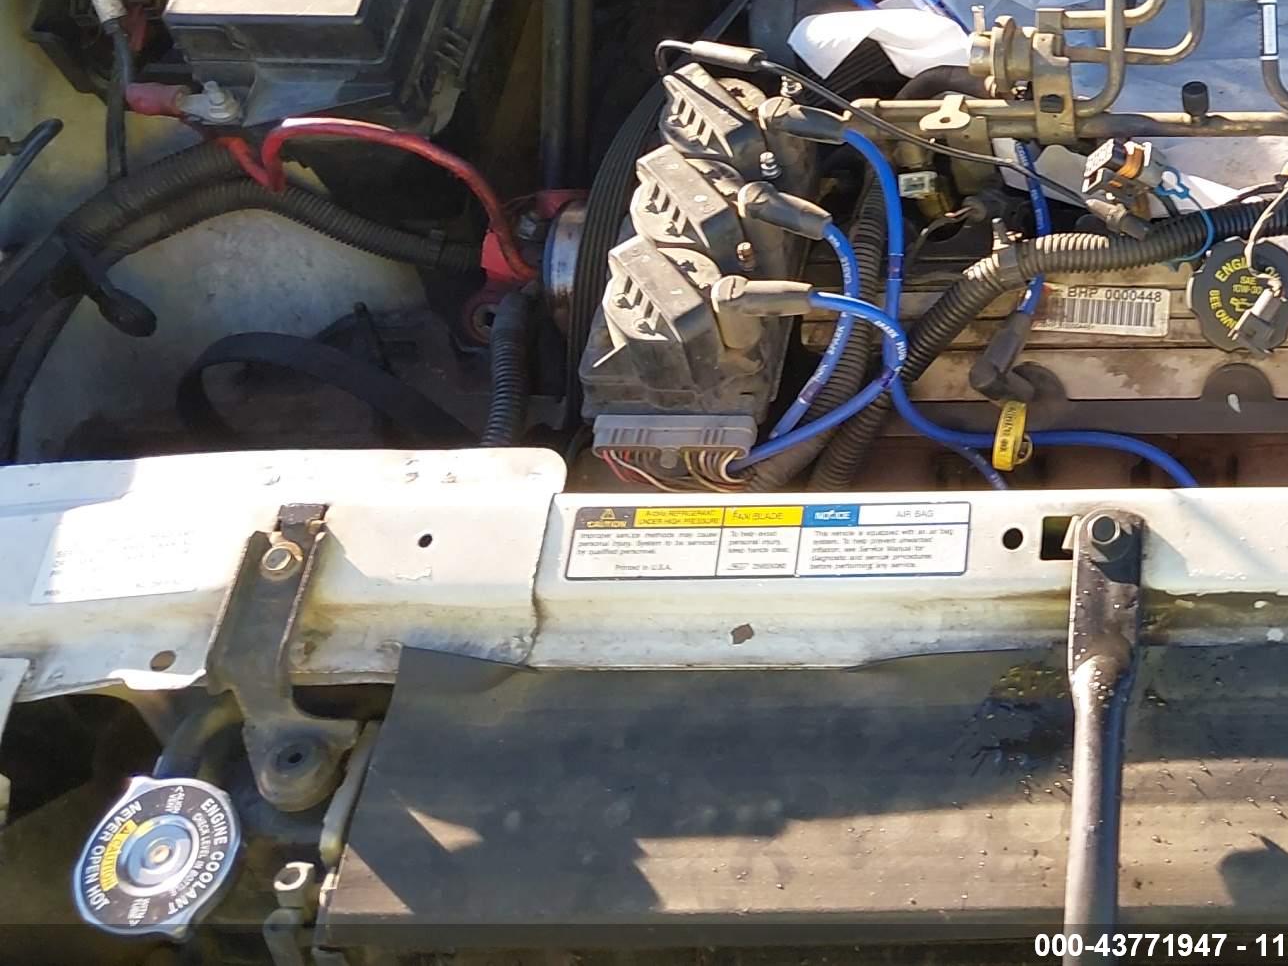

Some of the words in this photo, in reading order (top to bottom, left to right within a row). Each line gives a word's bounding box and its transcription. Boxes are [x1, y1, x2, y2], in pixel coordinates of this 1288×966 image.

[1215, 257, 1248, 282] ENGI
[1240, 276, 1257, 284] SAE
[1068, 287, 1098, 297] BHP
[1105, 289, 1161, 302] 0000448
[1209, 290, 1222, 309] SEE
[733, 512, 751, 520] FAN
[914, 510, 934, 518] BAG
[99, 802, 142, 842] NEVER
[191, 812, 207, 836] CHECK
[200, 797, 228, 846] ENGINE
[197, 835, 210, 859] LEVEL
[84, 845, 106, 884] OPEN
[102, 835, 124, 885] CAUTION
[194, 860, 203, 870] IN
[167, 851, 225, 915] COOLANT
[87, 887, 111, 912] HOT
